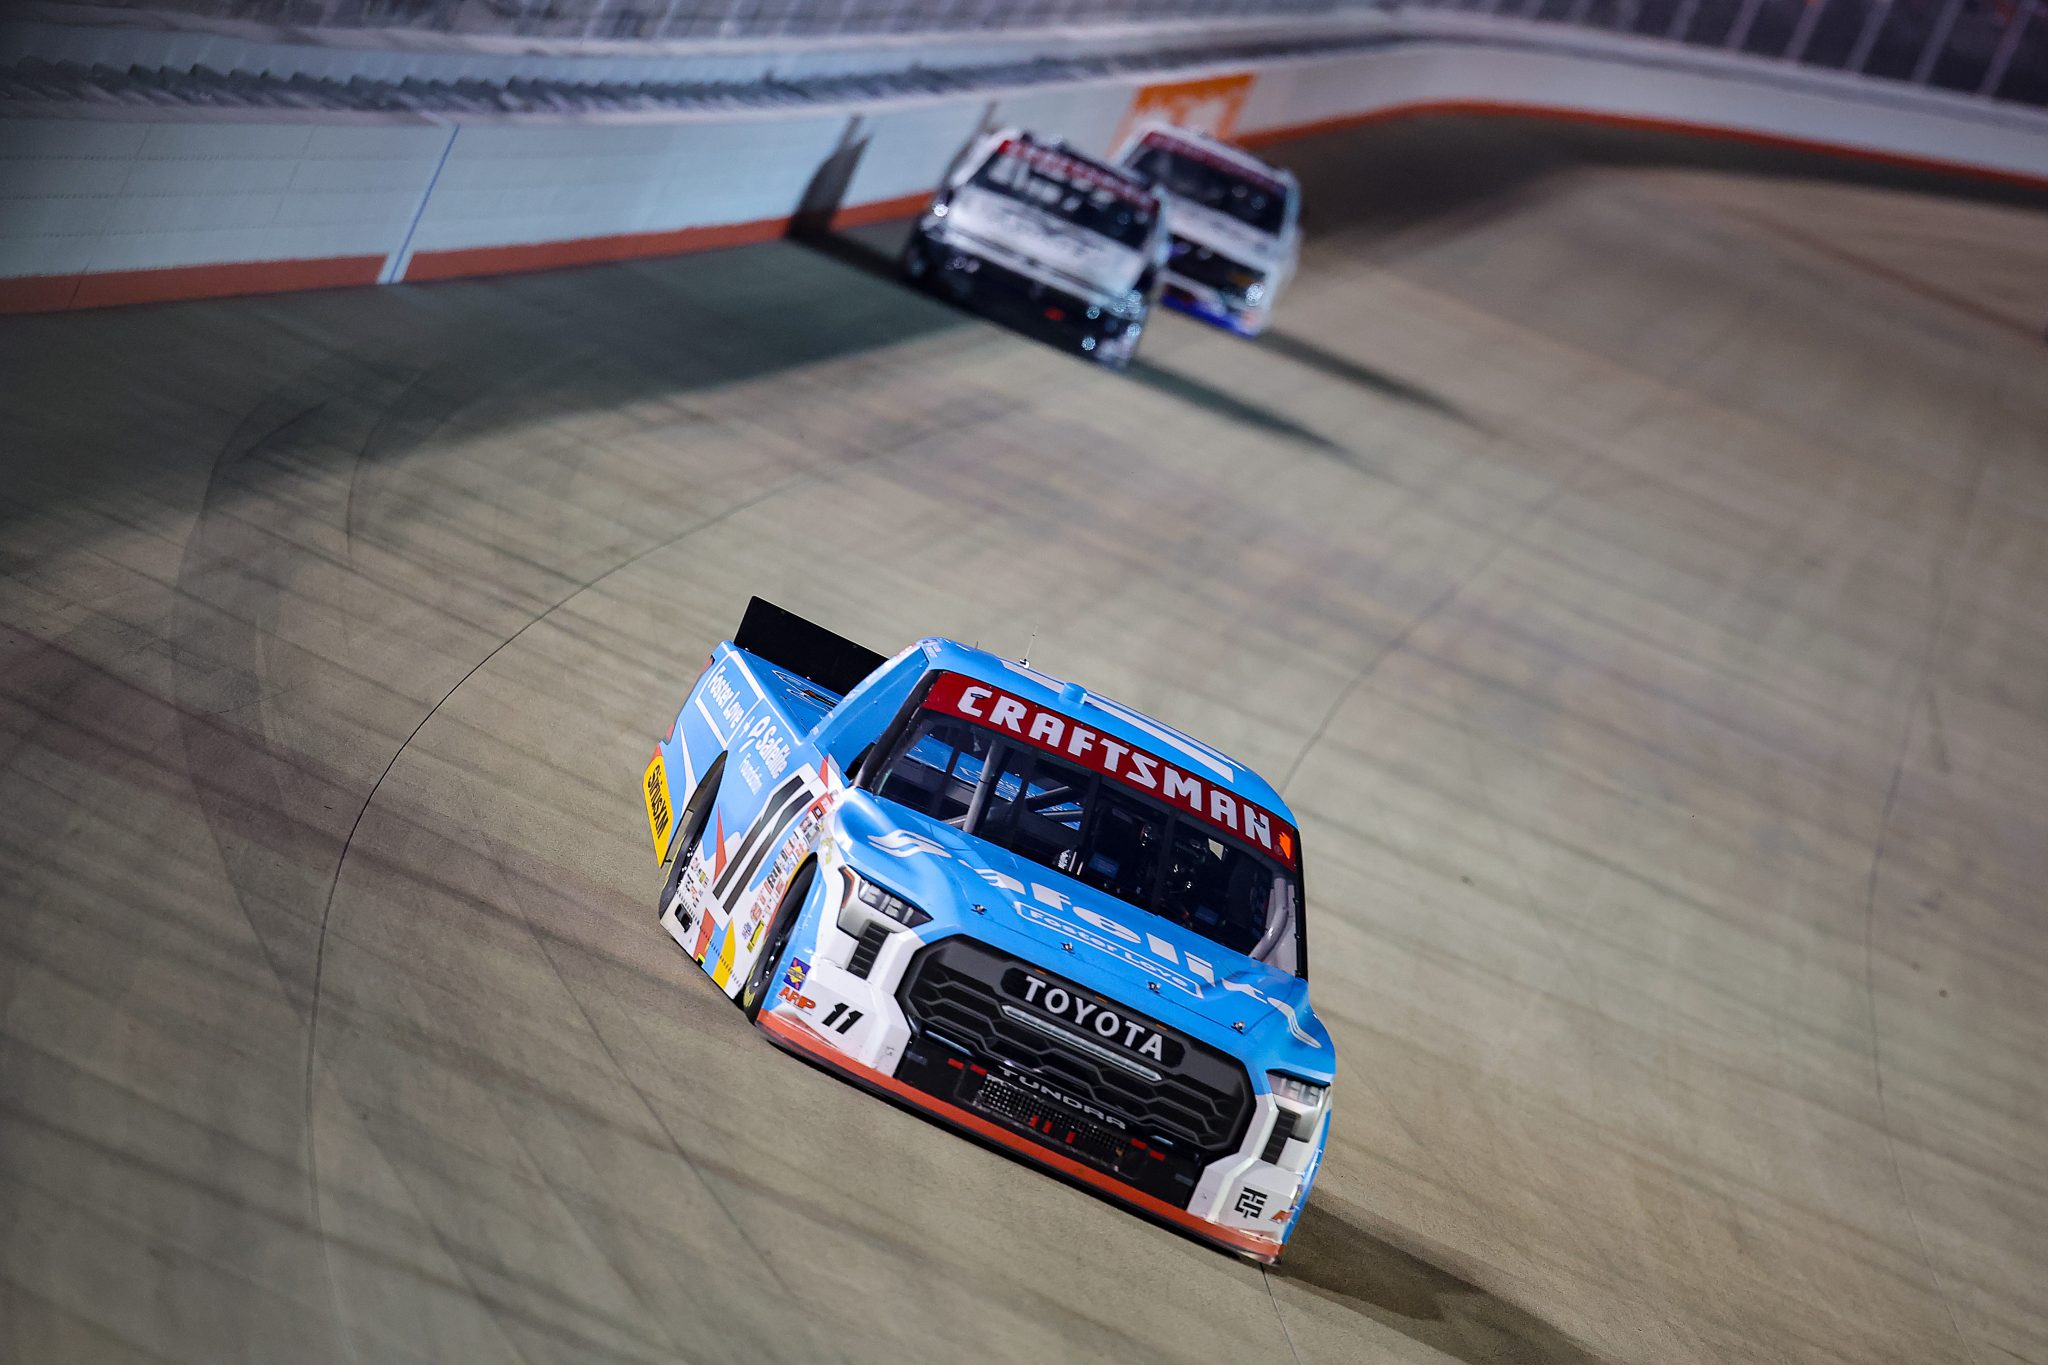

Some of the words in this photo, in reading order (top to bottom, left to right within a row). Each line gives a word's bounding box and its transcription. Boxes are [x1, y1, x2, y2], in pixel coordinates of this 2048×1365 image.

[707, 665, 735, 710] Foster
[722, 690, 745, 730] Love
[754, 725, 791, 780] Safelite
[957, 685, 1273, 850] CRAFTSMAN
[712, 775, 814, 915] 11
[1029, 909, 1118, 952] Foster
[1123, 951, 1189, 987] Love
[821, 1002, 864, 1035] 11
[1025, 975, 1164, 1062] TOYOTA
[997, 1064, 1127, 1131] TUNDRA
